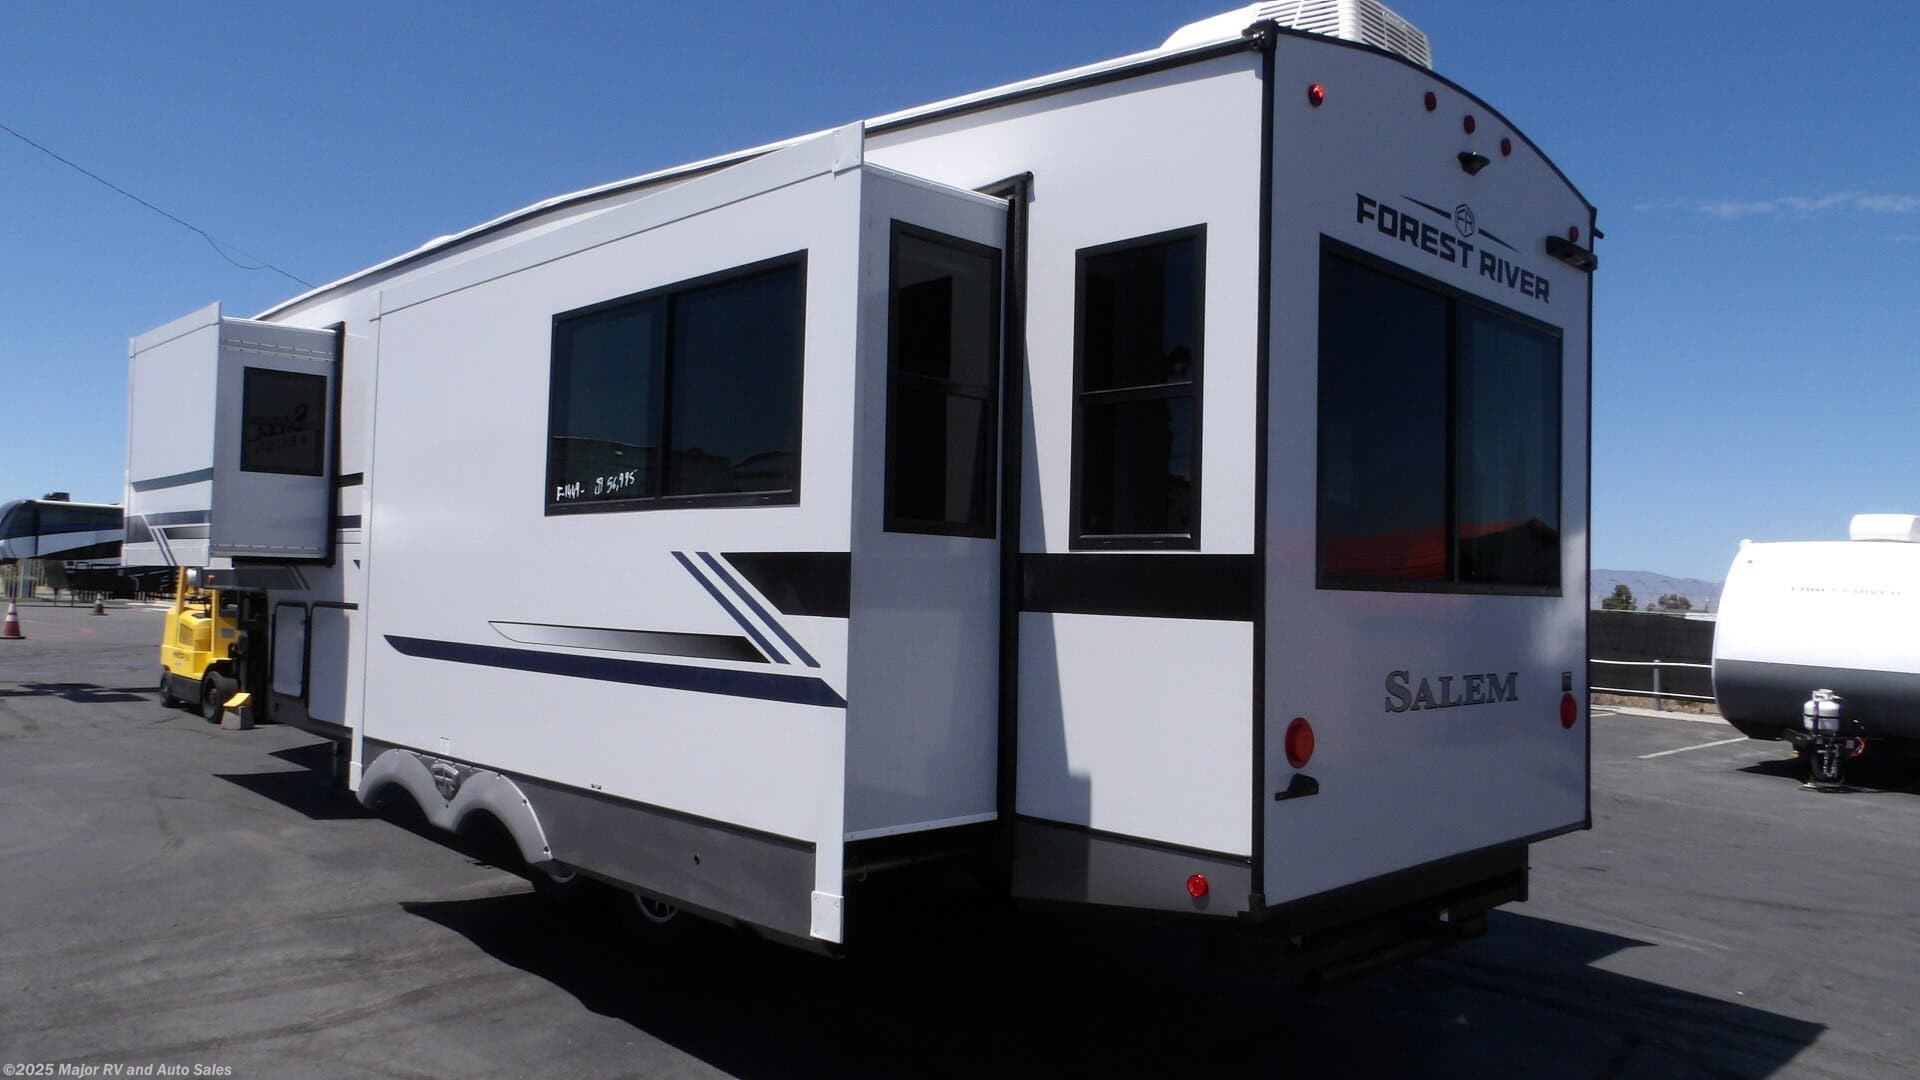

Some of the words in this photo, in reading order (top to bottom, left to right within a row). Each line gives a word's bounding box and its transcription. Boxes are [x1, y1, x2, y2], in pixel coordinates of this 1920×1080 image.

[1356, 192, 1474, 269] FOREST
[1479, 248, 1550, 304] RIVER
[1384, 670, 1519, 713] SALEM
